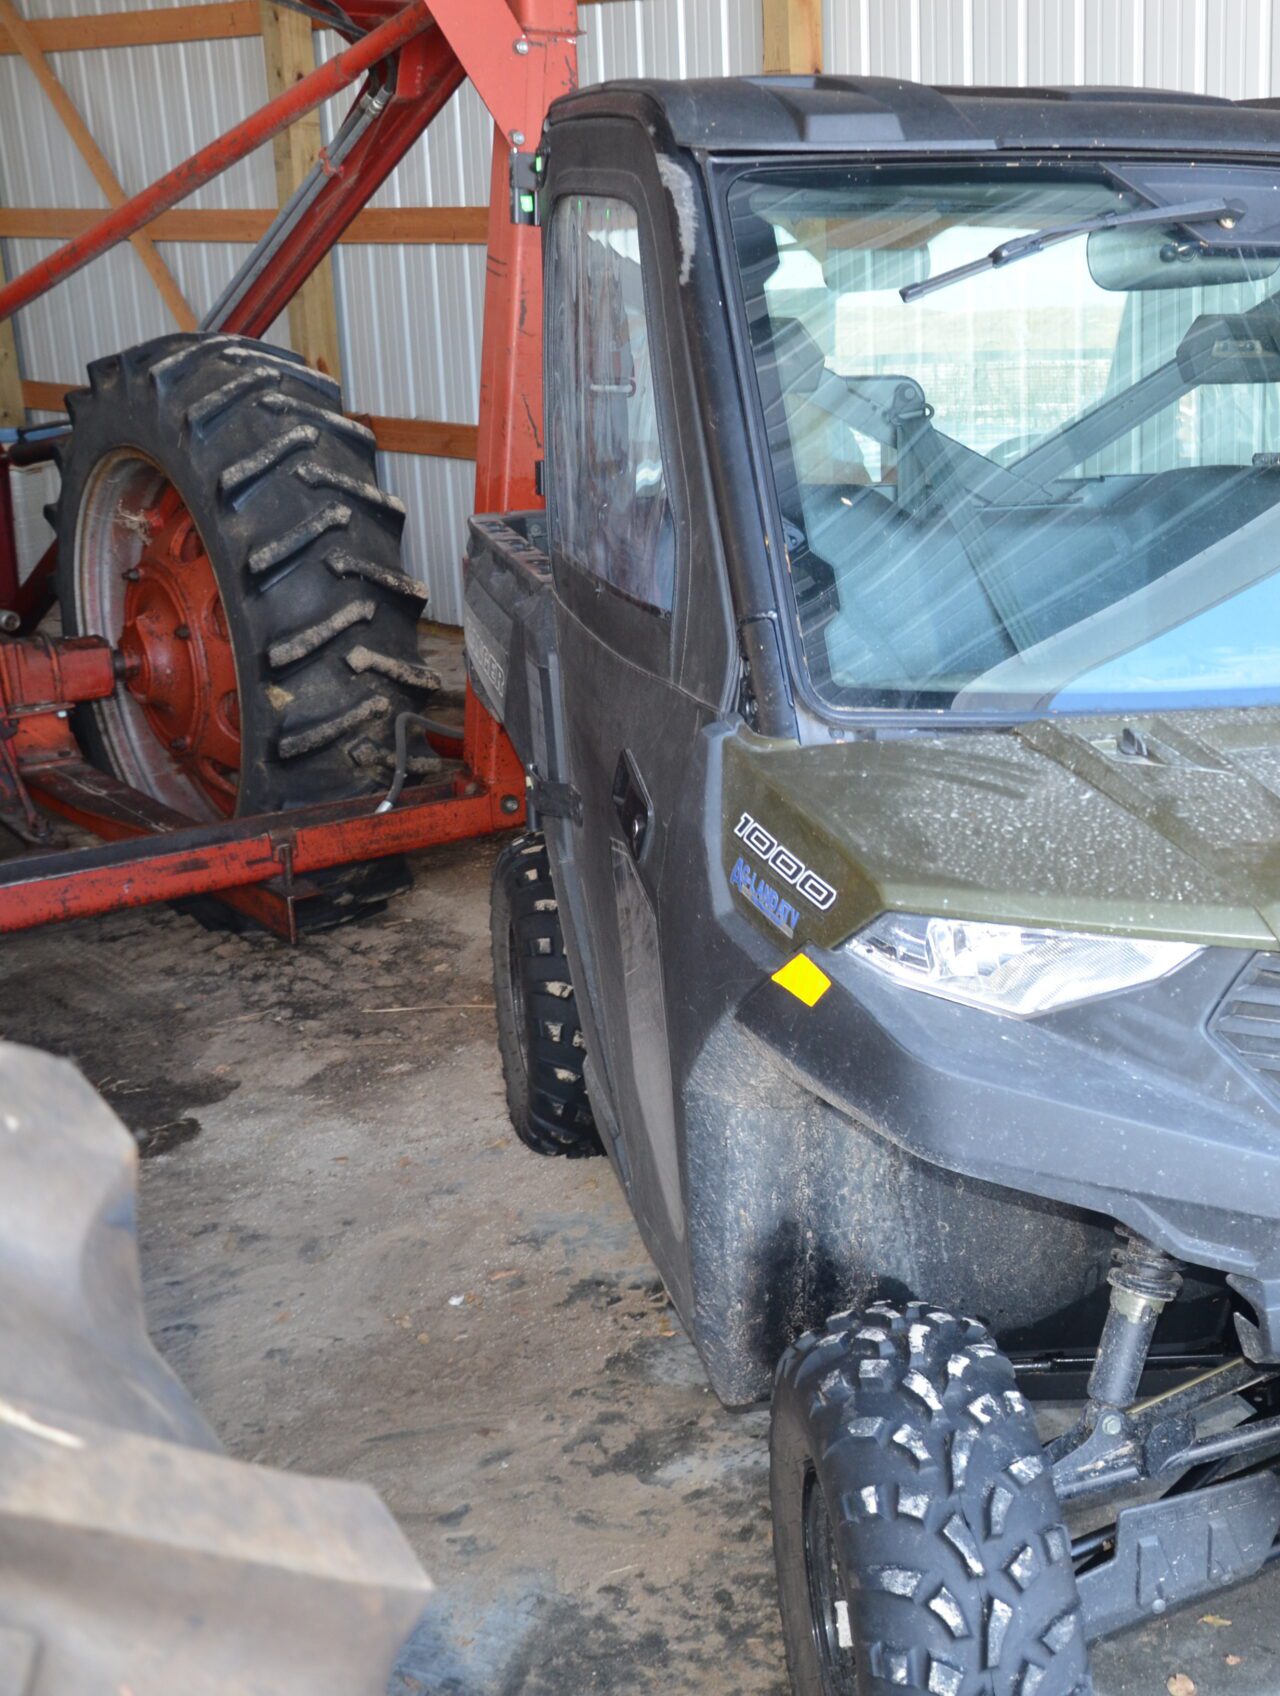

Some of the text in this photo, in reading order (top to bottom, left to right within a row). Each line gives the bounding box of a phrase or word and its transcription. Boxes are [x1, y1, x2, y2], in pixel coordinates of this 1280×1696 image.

[730, 856, 800, 930] AG-LAND ATV
[733, 811, 837, 911] 1000
